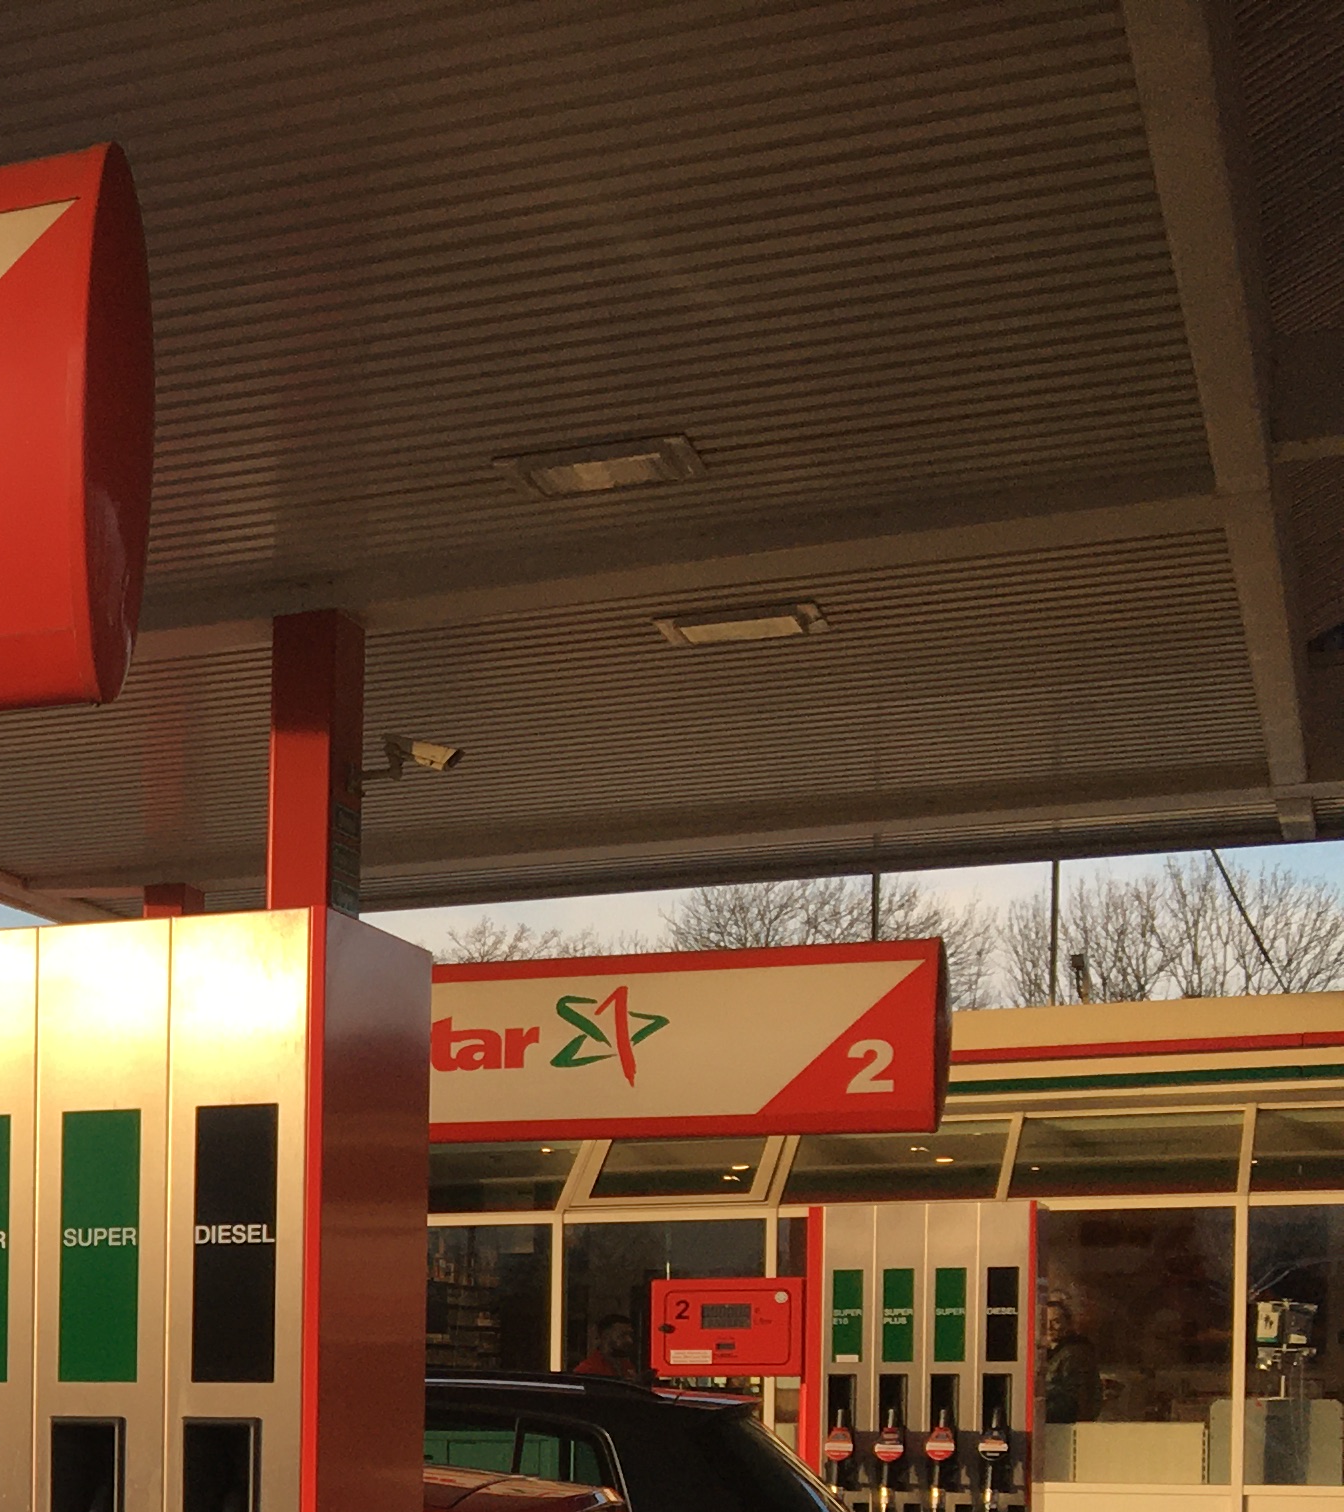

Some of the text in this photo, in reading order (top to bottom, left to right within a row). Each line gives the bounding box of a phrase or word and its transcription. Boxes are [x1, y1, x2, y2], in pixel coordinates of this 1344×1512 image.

[430, 1015, 540, 1072] tar
[846, 1039, 894, 1094] 2
[62, 1226, 137, 1247] SUPER
[194, 1223, 275, 1245] DIESEL
[675, 1299, 690, 1320] 2
[833, 1308, 862, 1317] SUPER
[884, 1308, 913, 1316] SUPER
[935, 1307, 965, 1316] SUPER
[986, 1307, 1018, 1315] DIESEL
[883, 1316, 907, 1325] PLUS
